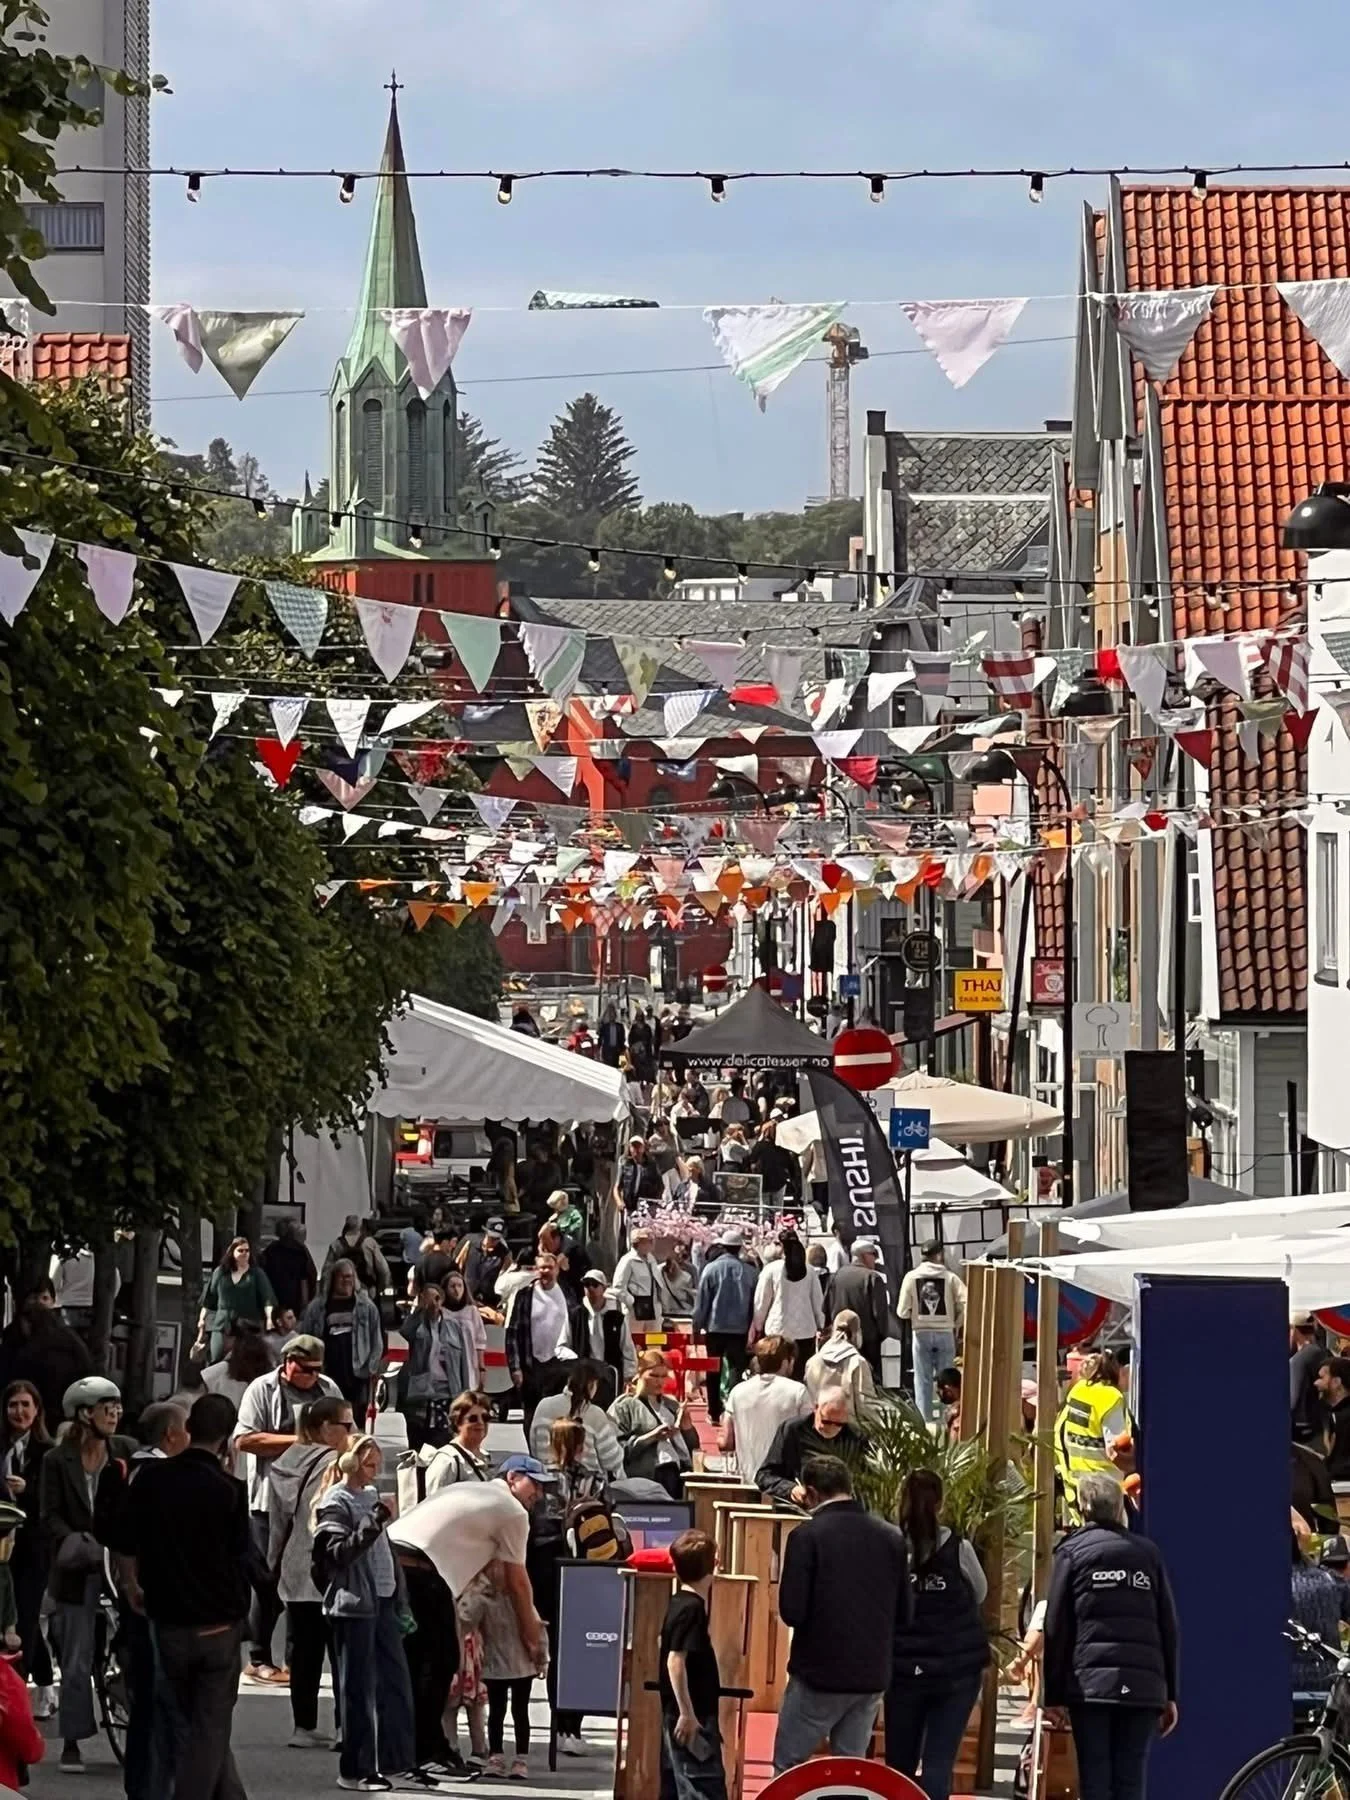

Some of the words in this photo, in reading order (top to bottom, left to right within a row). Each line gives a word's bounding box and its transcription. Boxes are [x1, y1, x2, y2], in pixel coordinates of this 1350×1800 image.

[961, 979, 1001, 992] THAI
[687, 1053, 830, 1068] www.delicatessenno
[1092, 1569, 1126, 1582] coop
[585, 1631, 618, 1643] coop
